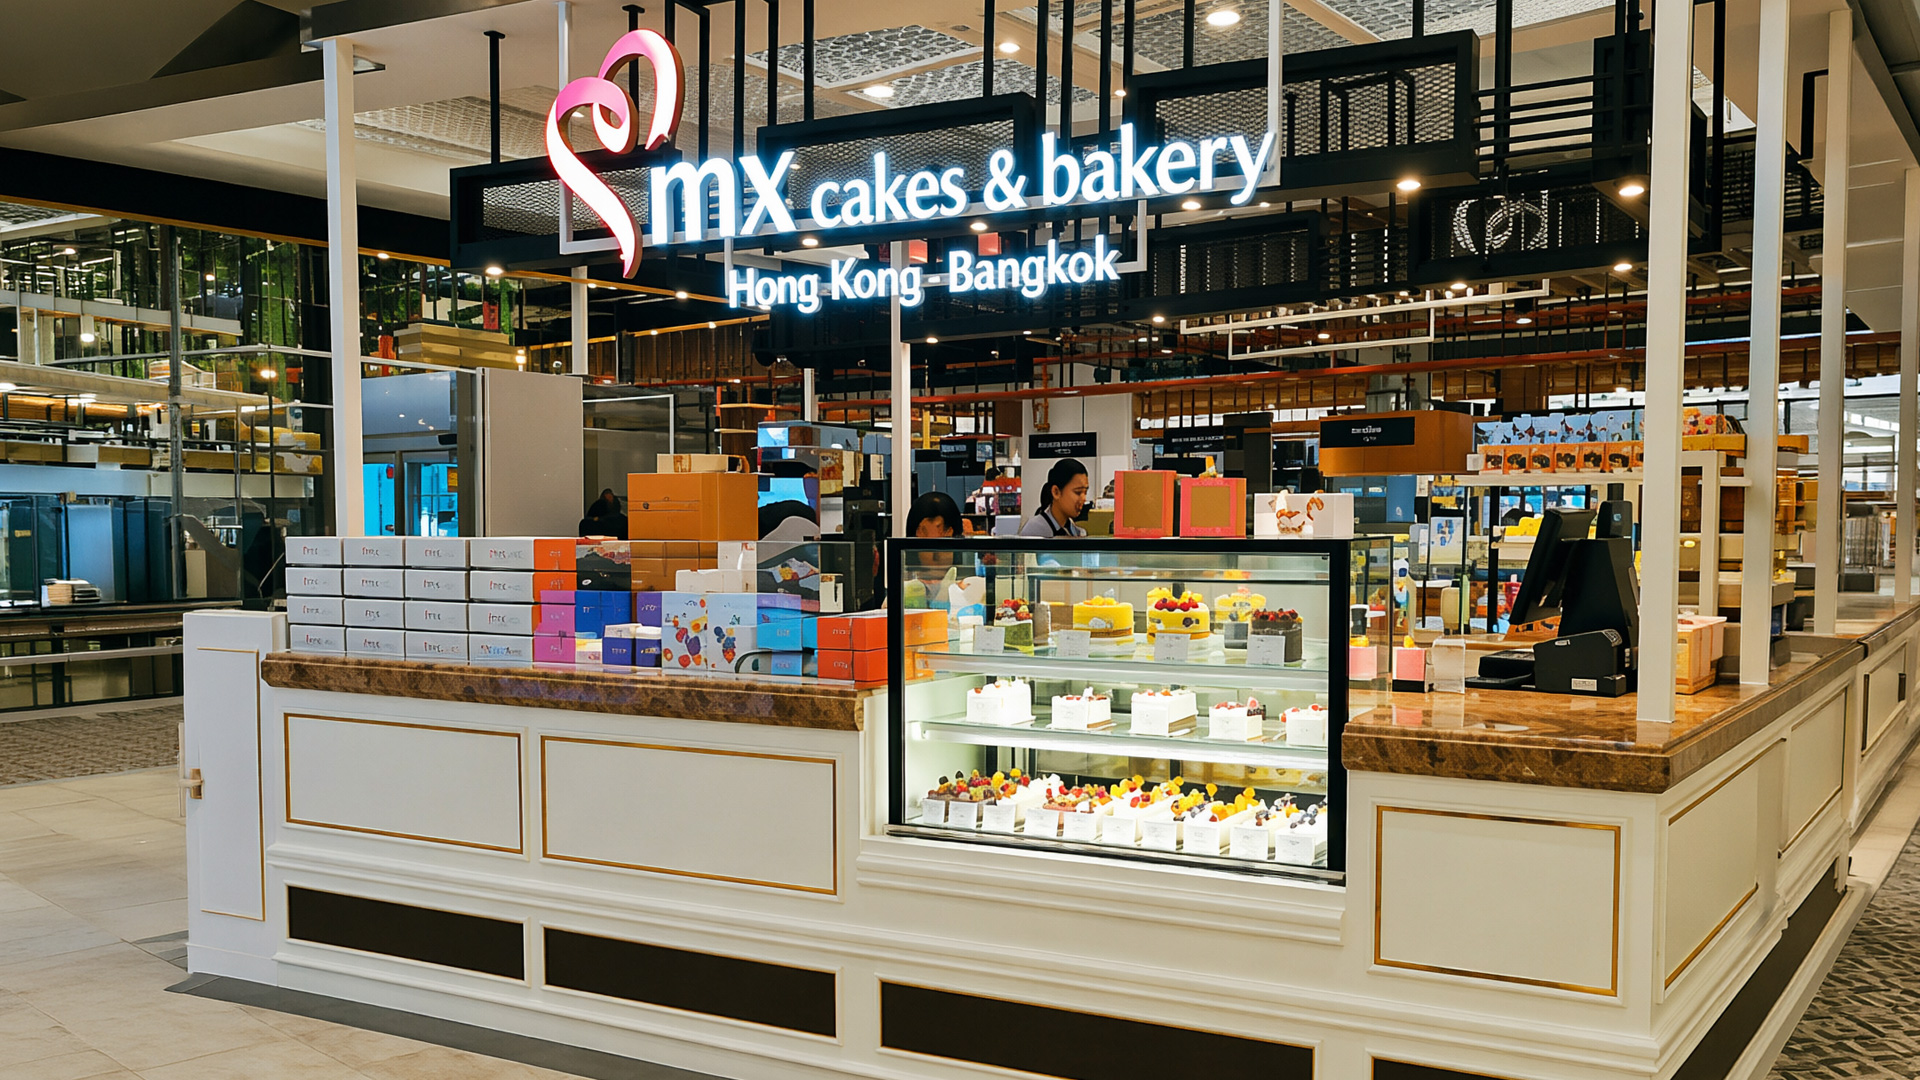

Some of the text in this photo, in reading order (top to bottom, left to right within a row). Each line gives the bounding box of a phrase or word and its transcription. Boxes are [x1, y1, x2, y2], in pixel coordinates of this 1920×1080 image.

[649, 122, 1275, 245] mx cakes & bakery
[728, 267, 821, 314] Hong
[831, 257, 923, 307] Kong
[949, 234, 1120, 299] Bangkok
